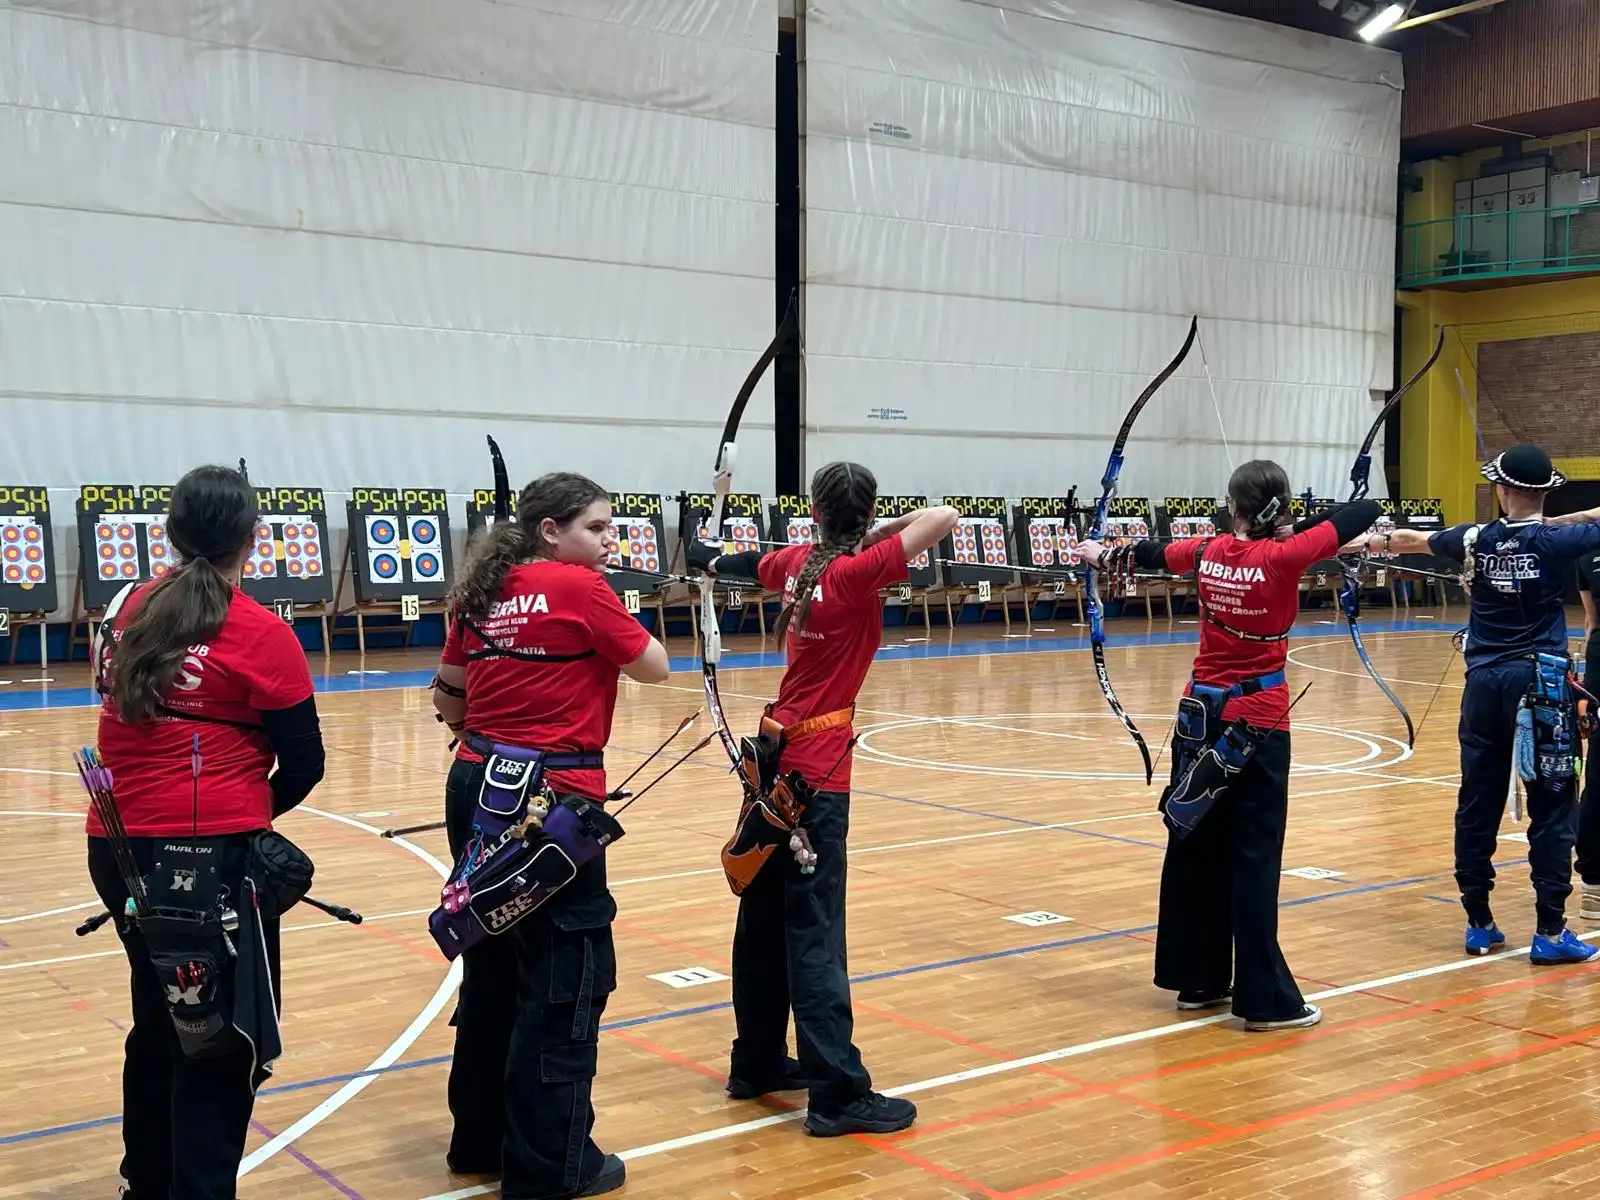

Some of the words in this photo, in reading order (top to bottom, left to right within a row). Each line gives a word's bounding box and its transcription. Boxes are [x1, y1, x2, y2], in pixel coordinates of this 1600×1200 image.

[83, 486, 134, 513] PSH
[142, 488, 170, 512] PS
[278, 490, 323, 512] PSH
[355, 490, 399, 512] PSH
[404, 490, 446, 513] PSH
[627, 495, 661, 515] PSH
[690, 495, 716, 511] PS
[728, 495, 762, 516] PSH
[780, 495, 811, 516] PSH
[876, 498, 895, 516] SH
[978, 497, 1006, 516] PSH
[1024, 499, 1050, 516] PSH
[1125, 499, 1149, 515] PSH
[1167, 499, 1192, 515] PSH
[1194, 499, 1217, 515] PSH
[1377, 500, 1395, 515] SH
[900, 586, 911, 600] 20
[979, 583, 990, 596] 21
[1055, 581, 1065, 594] 22
[404, 600, 418, 615] 15
[488, 593, 549, 618] BRAVA
[626, 594, 638, 609] 17
[729, 593, 741, 606] 18
[1210, 593, 1242, 606] ZAGREB
[276, 604, 292, 621] 14
[0, 613, 8, 630] 2
[164, 844, 213, 854] AVALON
[1021, 913, 1060, 923] 12
